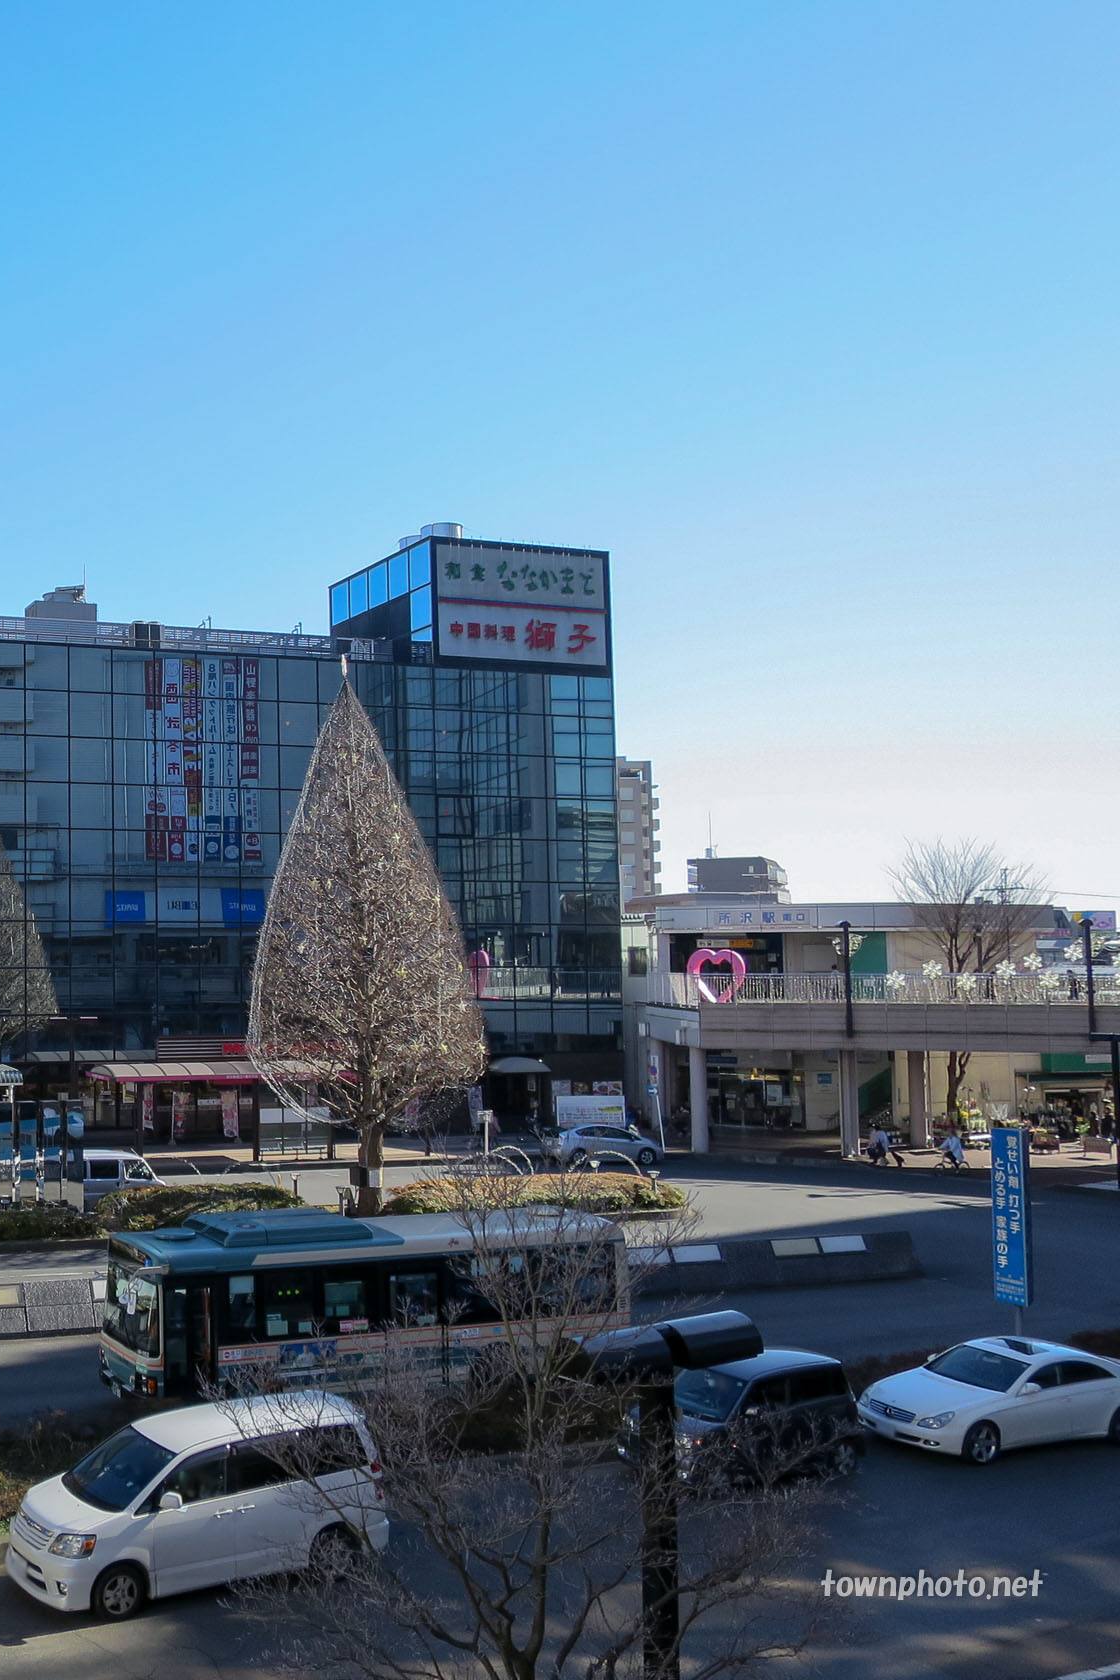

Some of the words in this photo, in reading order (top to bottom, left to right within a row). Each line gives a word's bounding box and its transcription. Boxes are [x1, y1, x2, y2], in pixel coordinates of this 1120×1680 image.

[496, 561, 596, 596] ななかまど
[994, 1157, 1007, 1210] とめる手
[1006, 1136, 1020, 1189] 覚せい剤
[1008, 1195, 1022, 1234] 打つ手
[996, 1216, 1009, 1269] 家族の手
